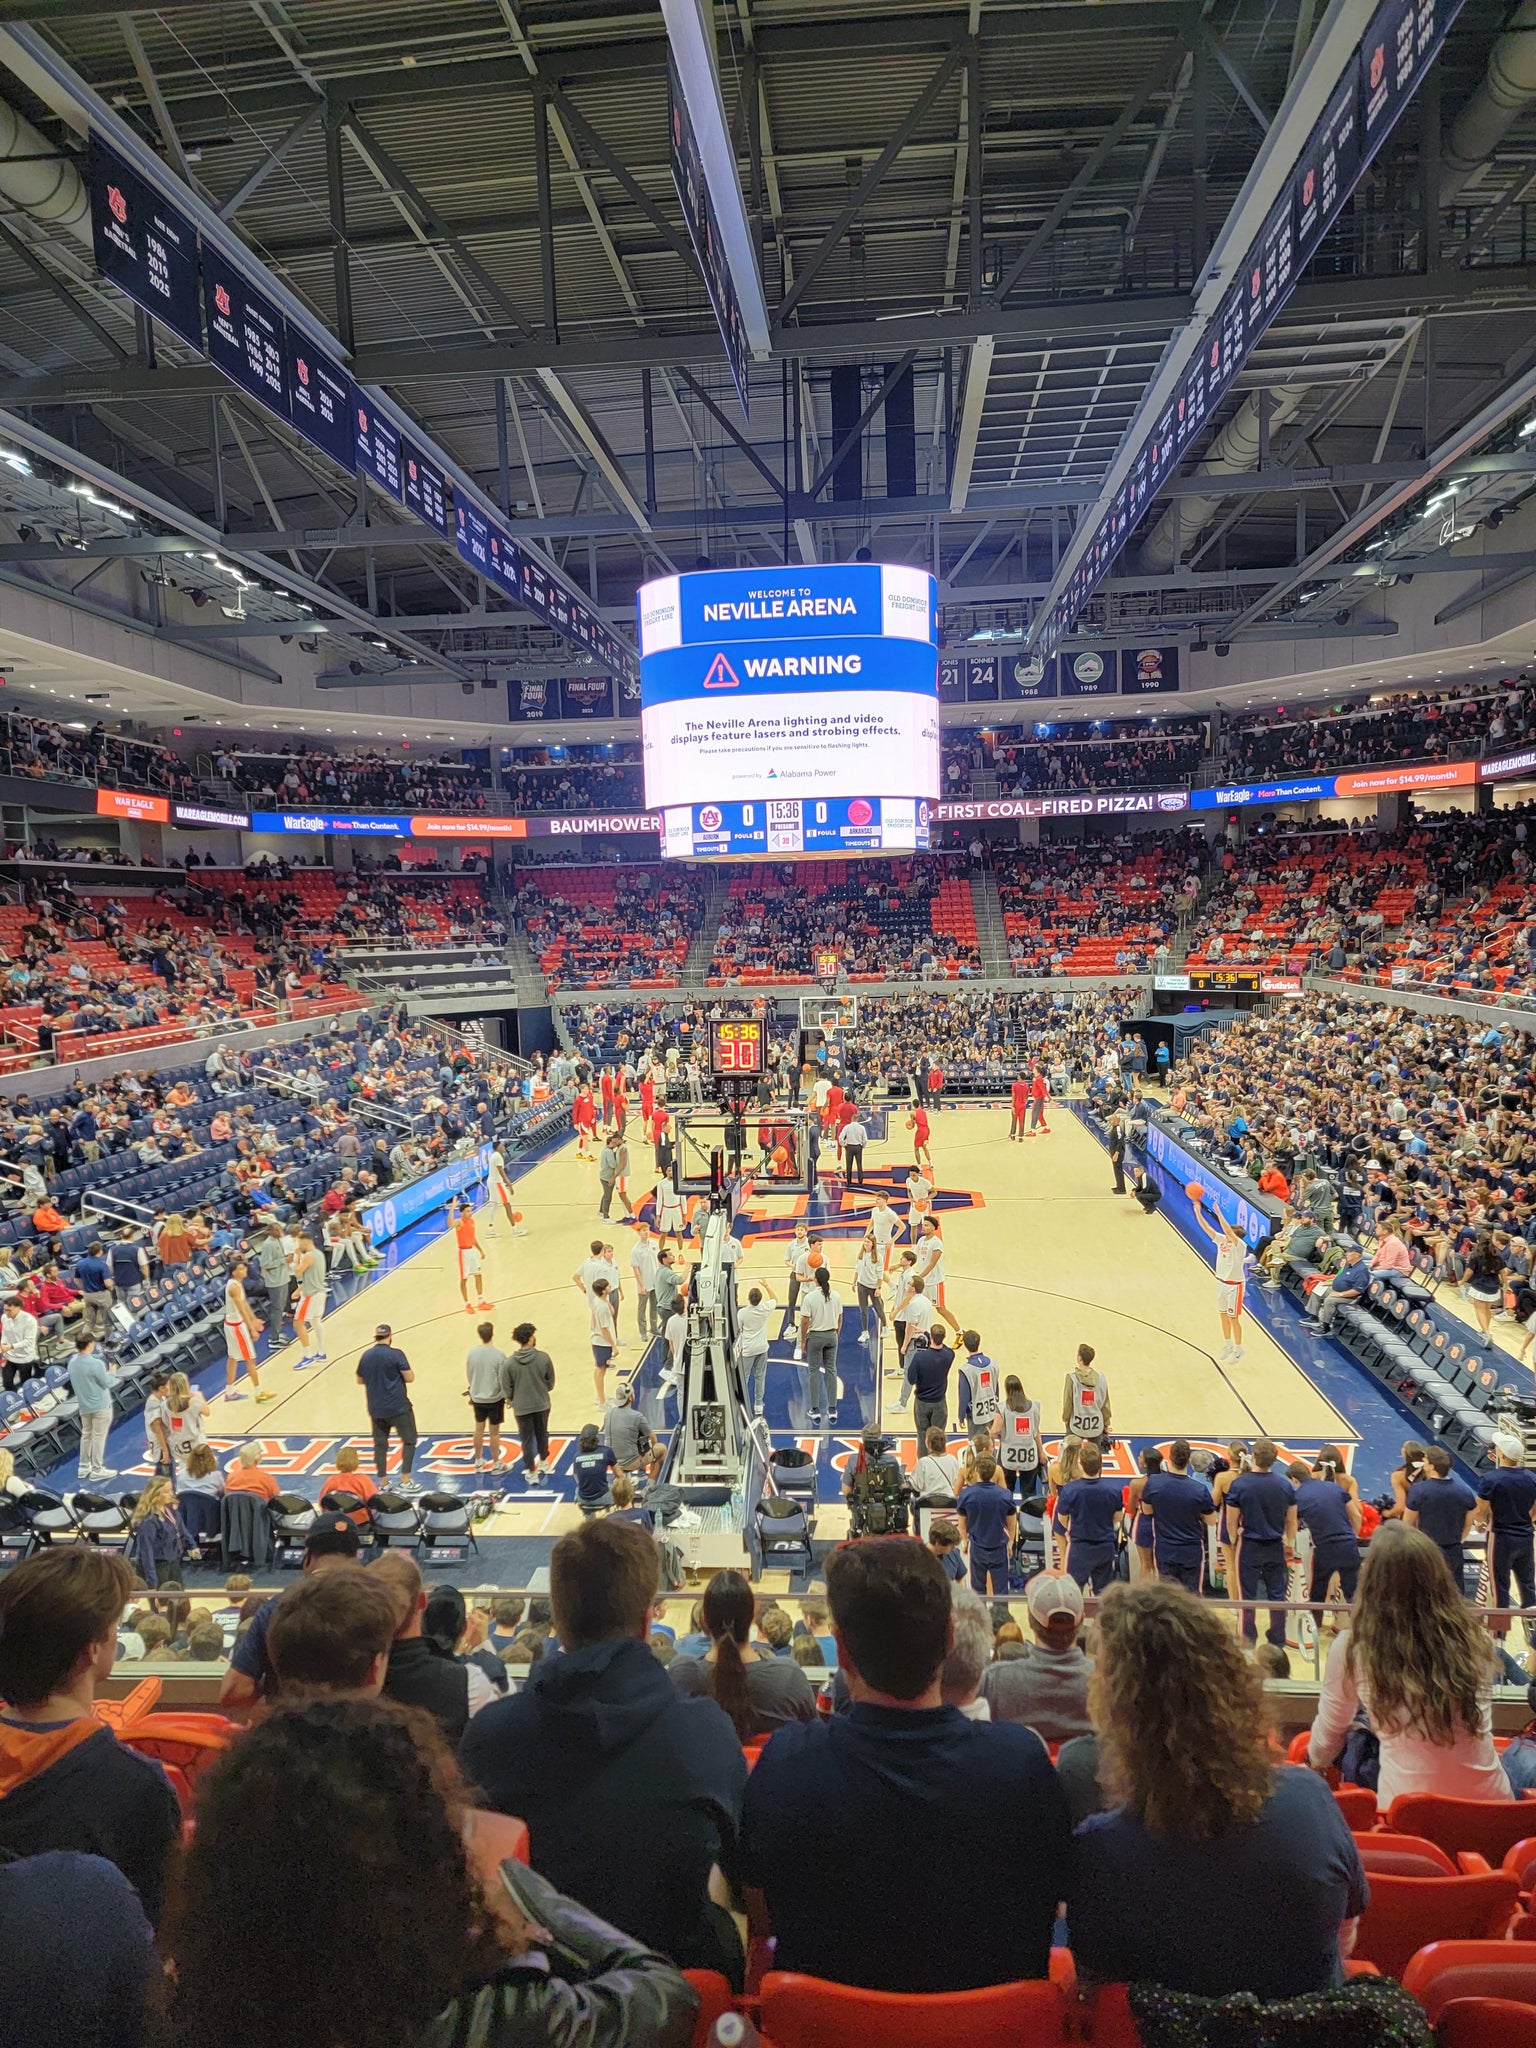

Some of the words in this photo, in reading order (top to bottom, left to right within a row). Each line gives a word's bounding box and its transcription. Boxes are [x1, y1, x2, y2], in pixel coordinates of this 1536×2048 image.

[148, 252, 168, 279] 2019
[149, 271, 170, 298] 2025
[748, 588, 796, 599] WELCOME
[798, 587, 811, 597] TO
[703, 600, 784, 622] NEVILLE
[786, 597, 857, 617] ARENA
[743, 655, 862, 678] WARNING
[941, 669, 958, 685] 21
[972, 666, 995, 684] 24
[525, 684, 544, 693] FINAL
[568, 683, 587, 692] FINAL
[587, 681, 606, 692] FOUR
[523, 692, 543, 700] FOUR
[685, 722, 704, 731] The
[706, 719, 745, 730] Neville
[747, 718, 780, 727] Arena
[784, 716, 828, 728] lighting
[830, 714, 851, 724] and
[854, 714, 884, 723] video
[670, 734, 709, 746] displays
[711, 731, 752, 741] feature
[754, 730, 786, 739] lasers
[789, 728, 809, 737] and
[812, 726, 860, 737] strobing
[862, 726, 901, 735] effects.
[731, 746, 766, 754] precautions
[780, 770, 813, 778] Alabama
[814, 769, 837, 777] Power
[1351, 779, 1369, 788] Join
[1369, 779, 1386, 787] now
[1386, 777, 1398, 785] for
[1399, 771, 1458, 784] $14.99/month!
[1258, 790, 1276, 798] More
[1276, 788, 1293, 796] Than
[1293, 785, 1322, 794] Content.
[114, 796, 131, 808] WAR
[132, 799, 155, 810] EAGLE
[770, 802, 799, 819] 15:36
[938, 804, 985, 819] FIRST
[987, 799, 1093, 817] COAL-FIRED
[1096, 796, 1153, 812] PIZZA!
[176, 806, 249, 827] WAREAGLEMOBILE.COM
[742, 804, 754, 827] 0
[815, 801, 828, 824] 0
[332, 820, 352, 829] More
[352, 821, 370, 829] Than
[370, 822, 400, 830] Content.
[426, 823, 441, 831] Join
[455, 823, 466, 831] for
[466, 823, 513, 832] $14.99/month!
[550, 817, 661, 834] BAUMHOWER
[849, 827, 873, 835] ARKANSAS
[819, 955, 836, 963] 15:36
[820, 963, 835, 974] 30
[1198, 979, 1204, 988] 0
[1215, 973, 1235, 981] 15:36
[1252, 980, 1258, 989] 0
[1262, 979, 1299, 990] Guthrie's
[720, 1024, 758, 1040] 15:36
[721, 1042, 754, 1069] 30
[976, 1400, 996, 1417] 235
[1073, 1415, 1100, 1431] 202
[1007, 1448, 1036, 1463] 208
